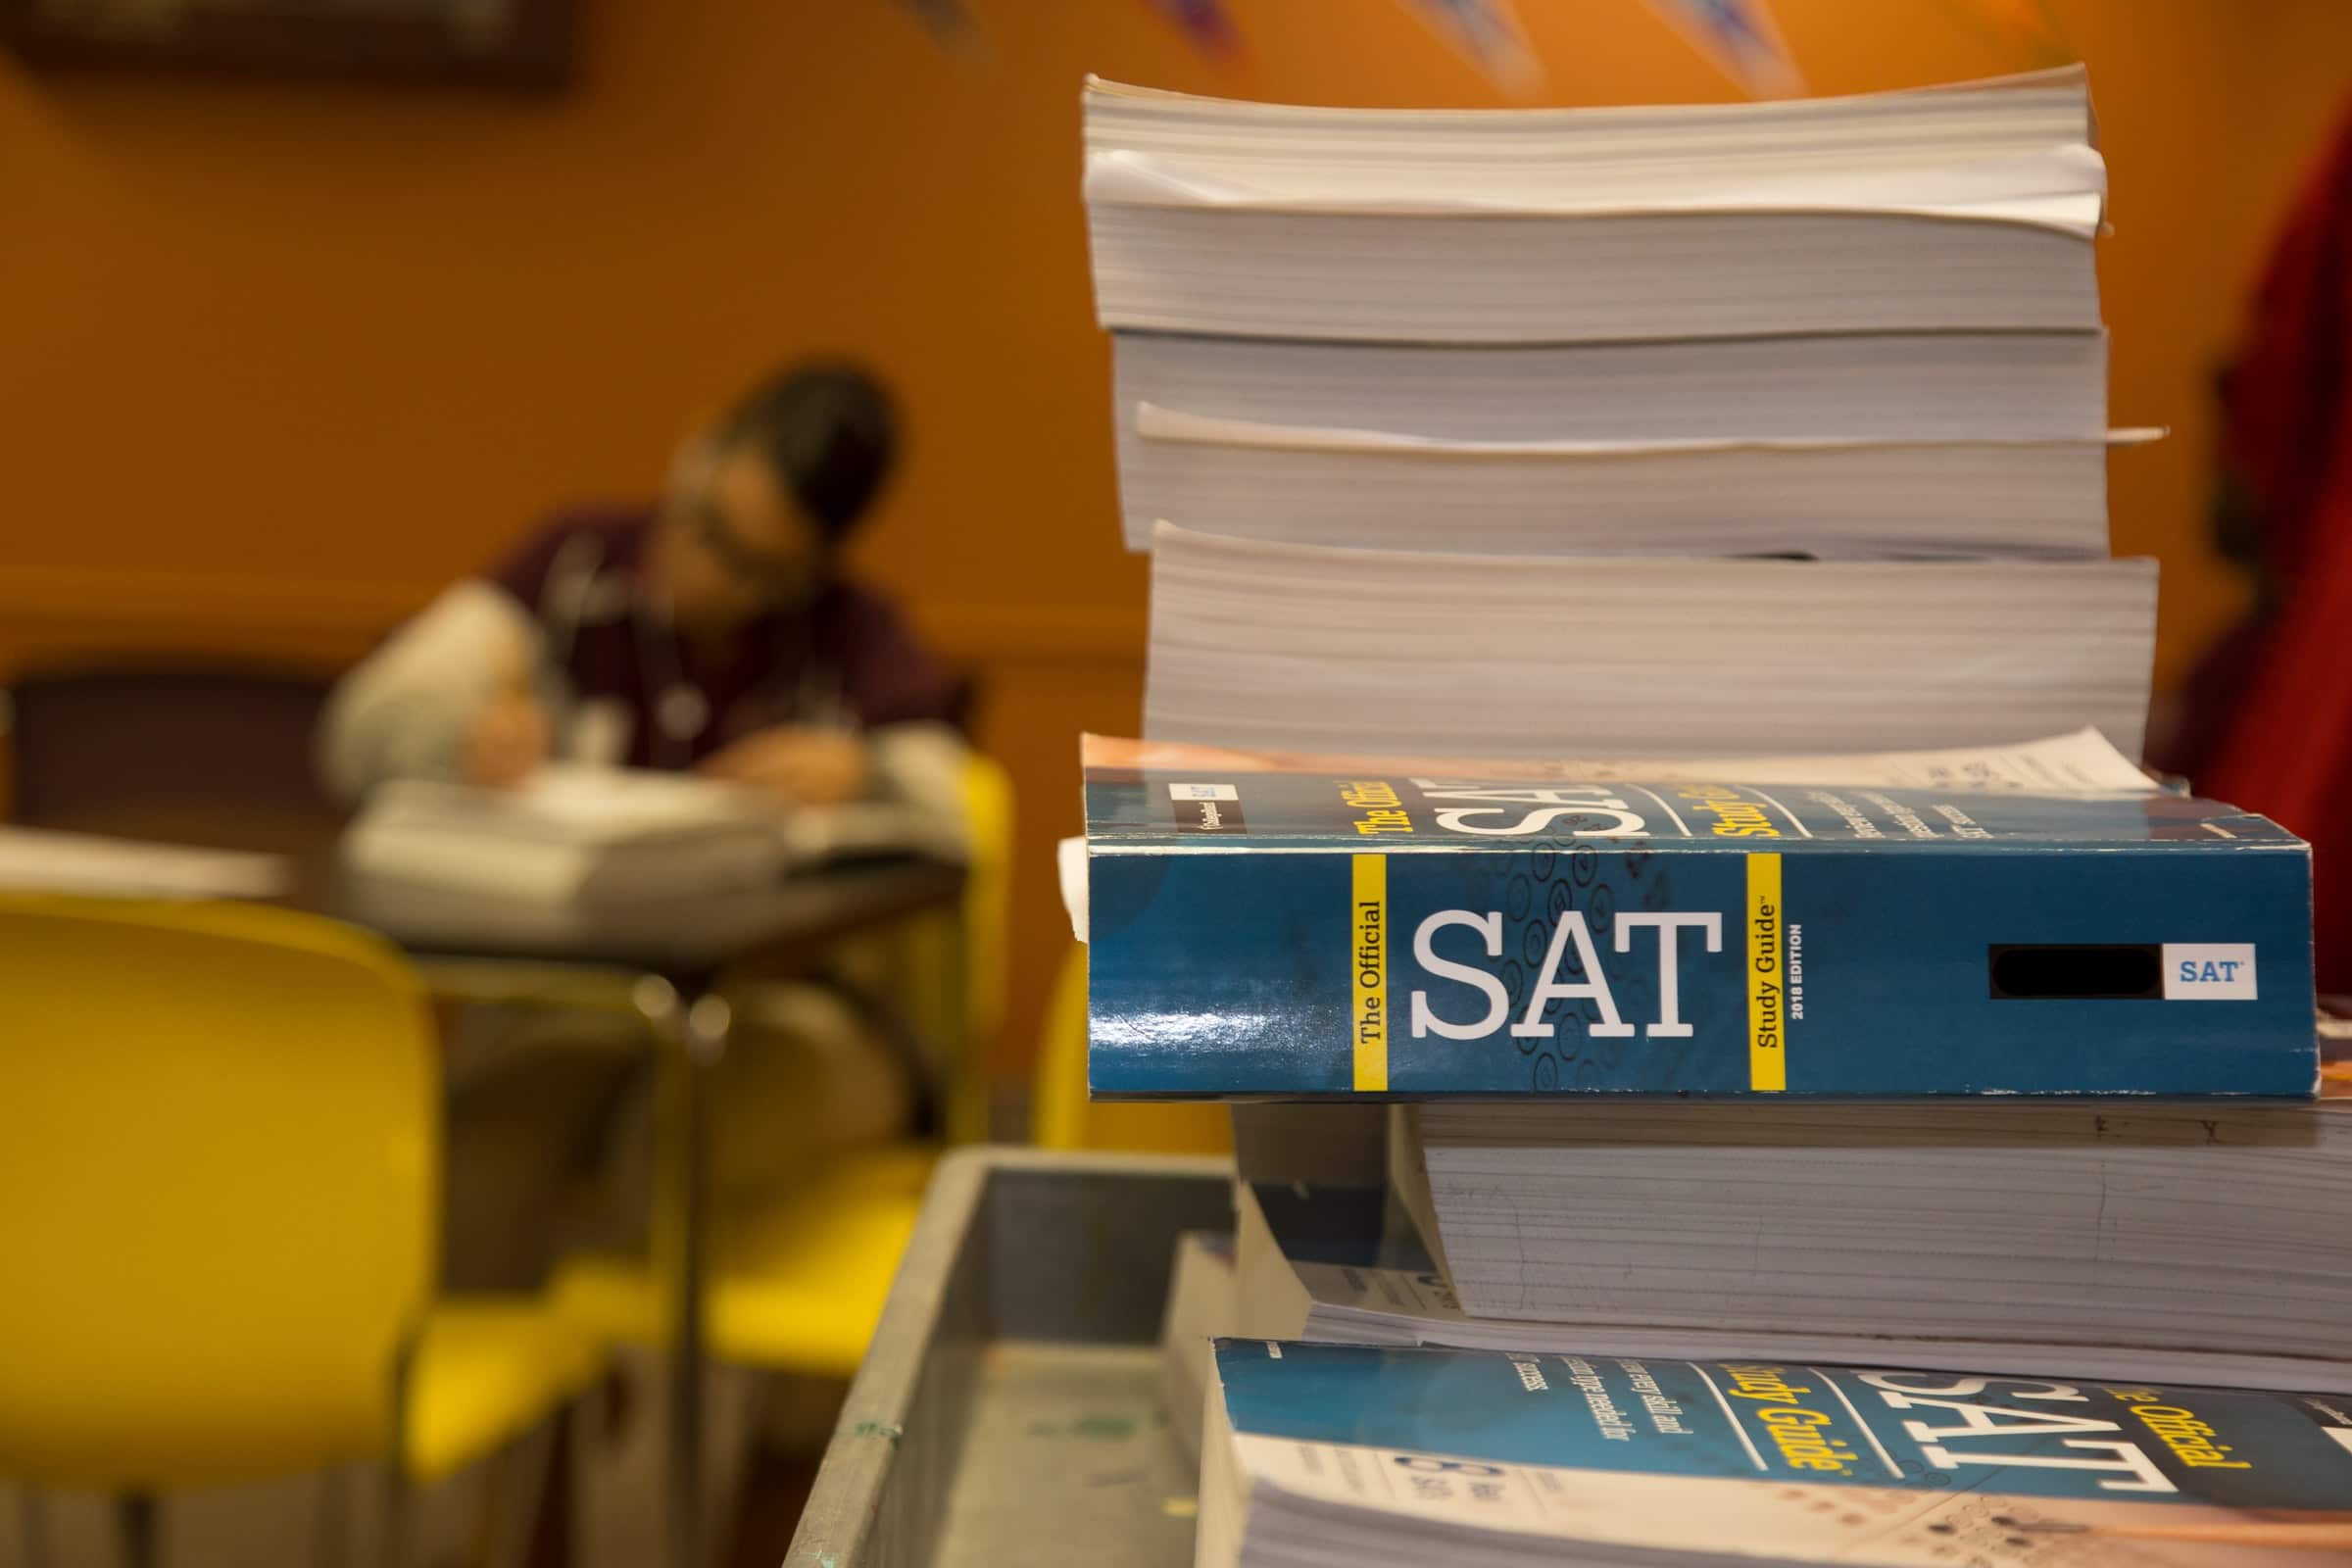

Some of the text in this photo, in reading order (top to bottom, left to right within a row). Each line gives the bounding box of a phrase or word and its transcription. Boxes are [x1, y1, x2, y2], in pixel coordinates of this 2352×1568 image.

[1352, 809, 1413, 835] The
[1692, 799, 1781, 839] Study
[1358, 901, 1381, 1045] The Official
[1410, 908, 1723, 1040] SAT
[1788, 923, 1804, 1020] 2018 EDITION
[1756, 980, 1781, 1049] Study
[1569, 1374, 1607, 1393] type
[1629, 1372, 1663, 1396] every
[1585, 1392, 1634, 1427] needed
[1641, 1394, 1684, 1415] skill
[1599, 1426, 1638, 1442] for
[1651, 1414, 1694, 1435] and
[1852, 1370, 2181, 1494] SAT
[2129, 1404, 2253, 1469] Official
